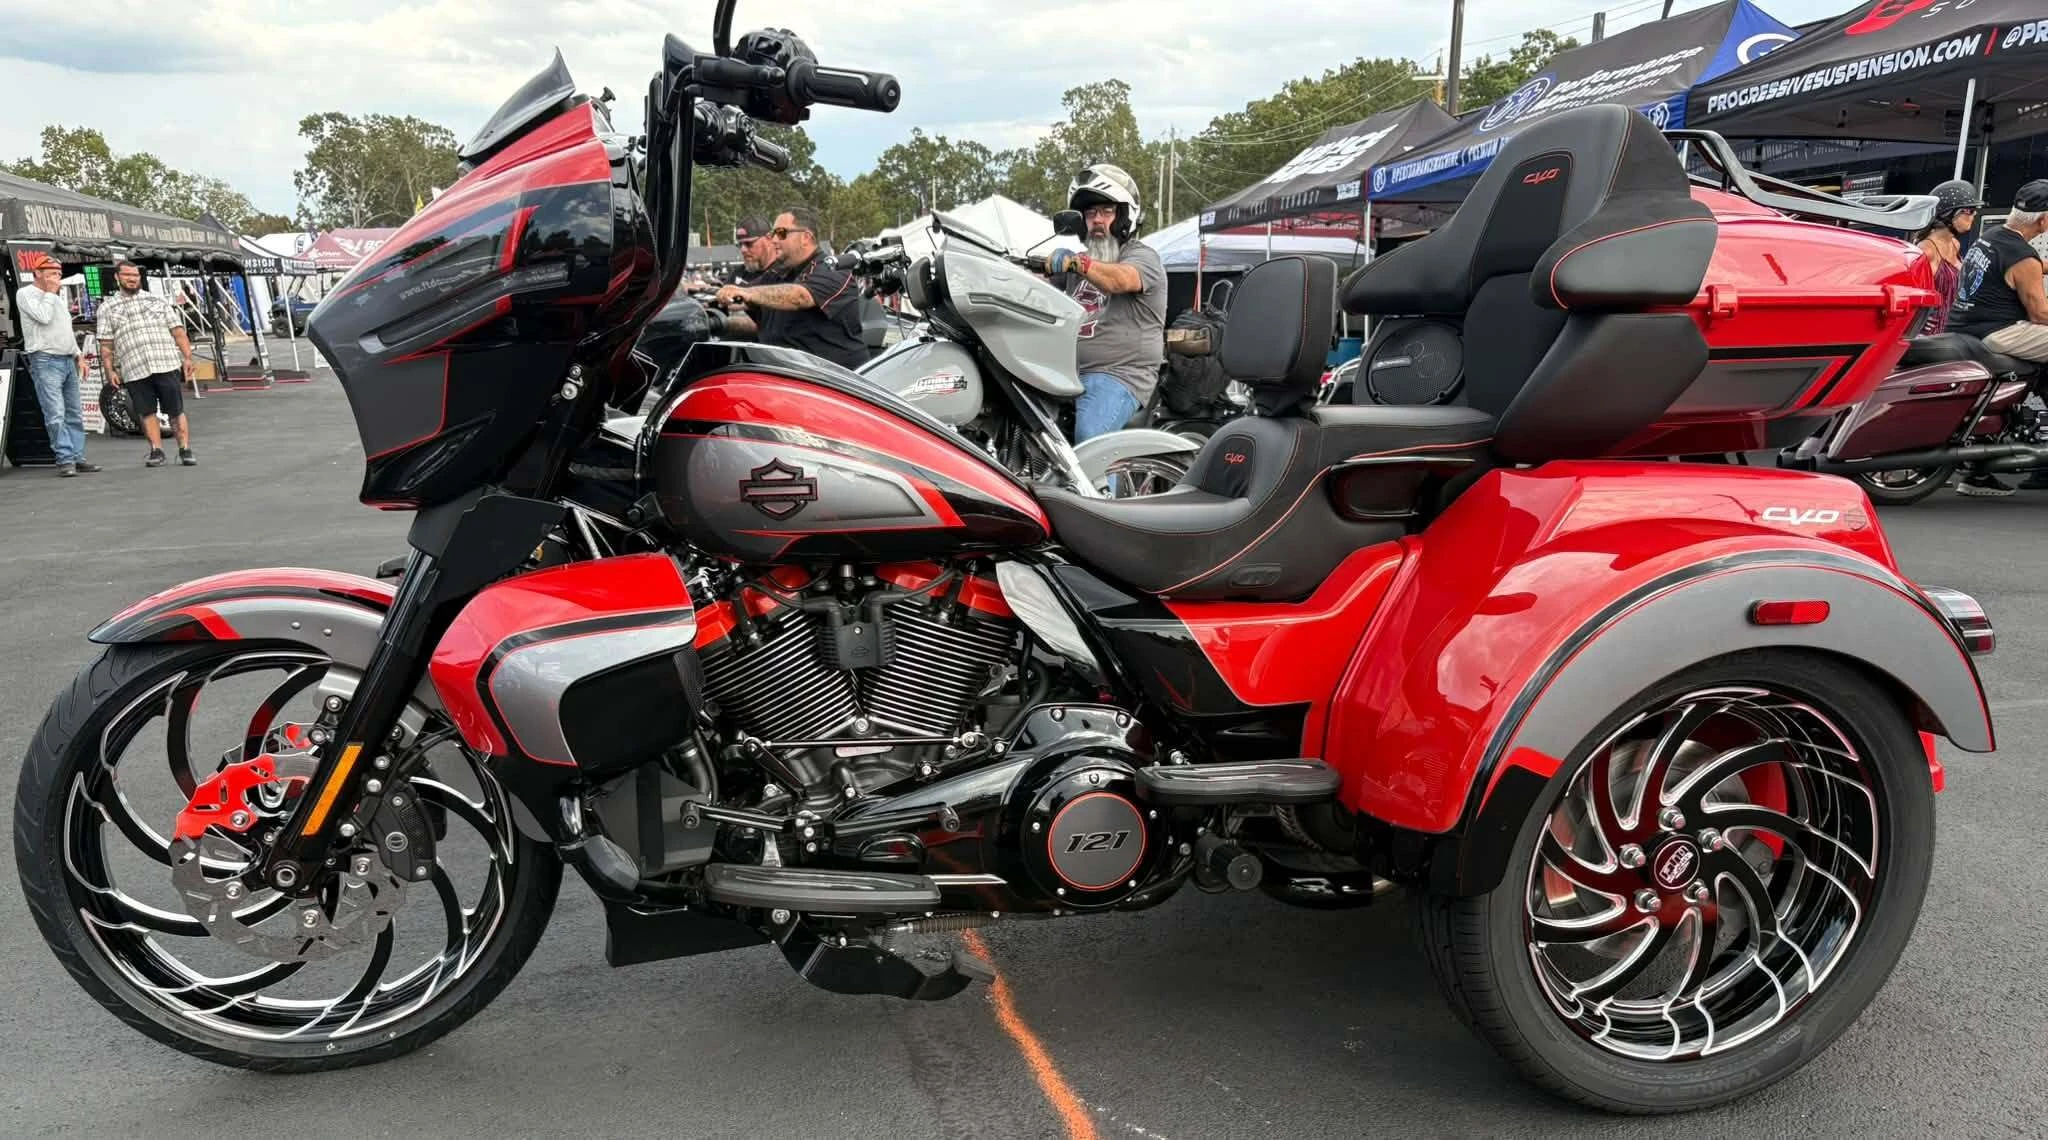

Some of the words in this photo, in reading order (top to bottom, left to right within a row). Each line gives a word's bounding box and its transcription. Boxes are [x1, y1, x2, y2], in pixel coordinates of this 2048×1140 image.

[1708, 33, 1982, 114] PROGRESSIVESUSPENSION.COM
[1762, 506, 1840, 525] CVO
[1064, 830, 1132, 853] 121
